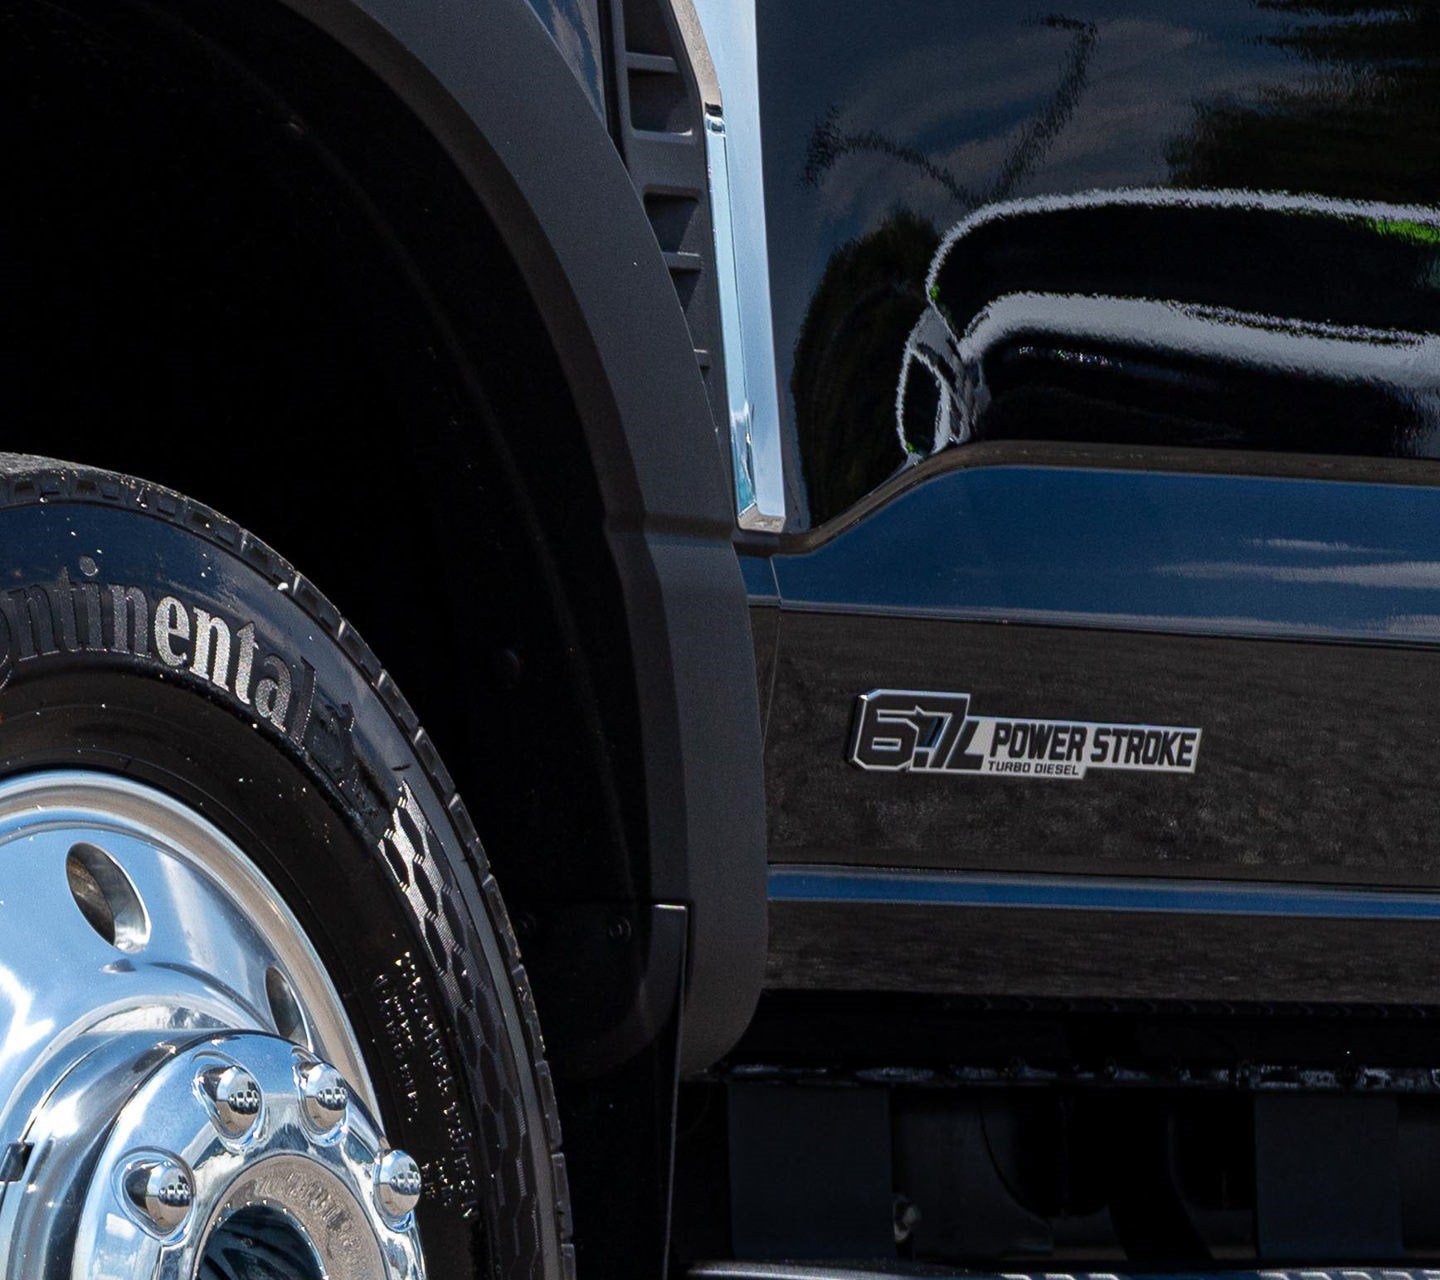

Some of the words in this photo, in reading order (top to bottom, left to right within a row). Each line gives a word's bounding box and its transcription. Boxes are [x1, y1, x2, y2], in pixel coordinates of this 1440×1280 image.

[856, 689, 986, 772] 6.7L
[988, 721, 1088, 762] POWER
[1090, 727, 1198, 768] STROKE
[987, 760, 1031, 774] TURBO
[1033, 763, 1080, 777] DIESEL
